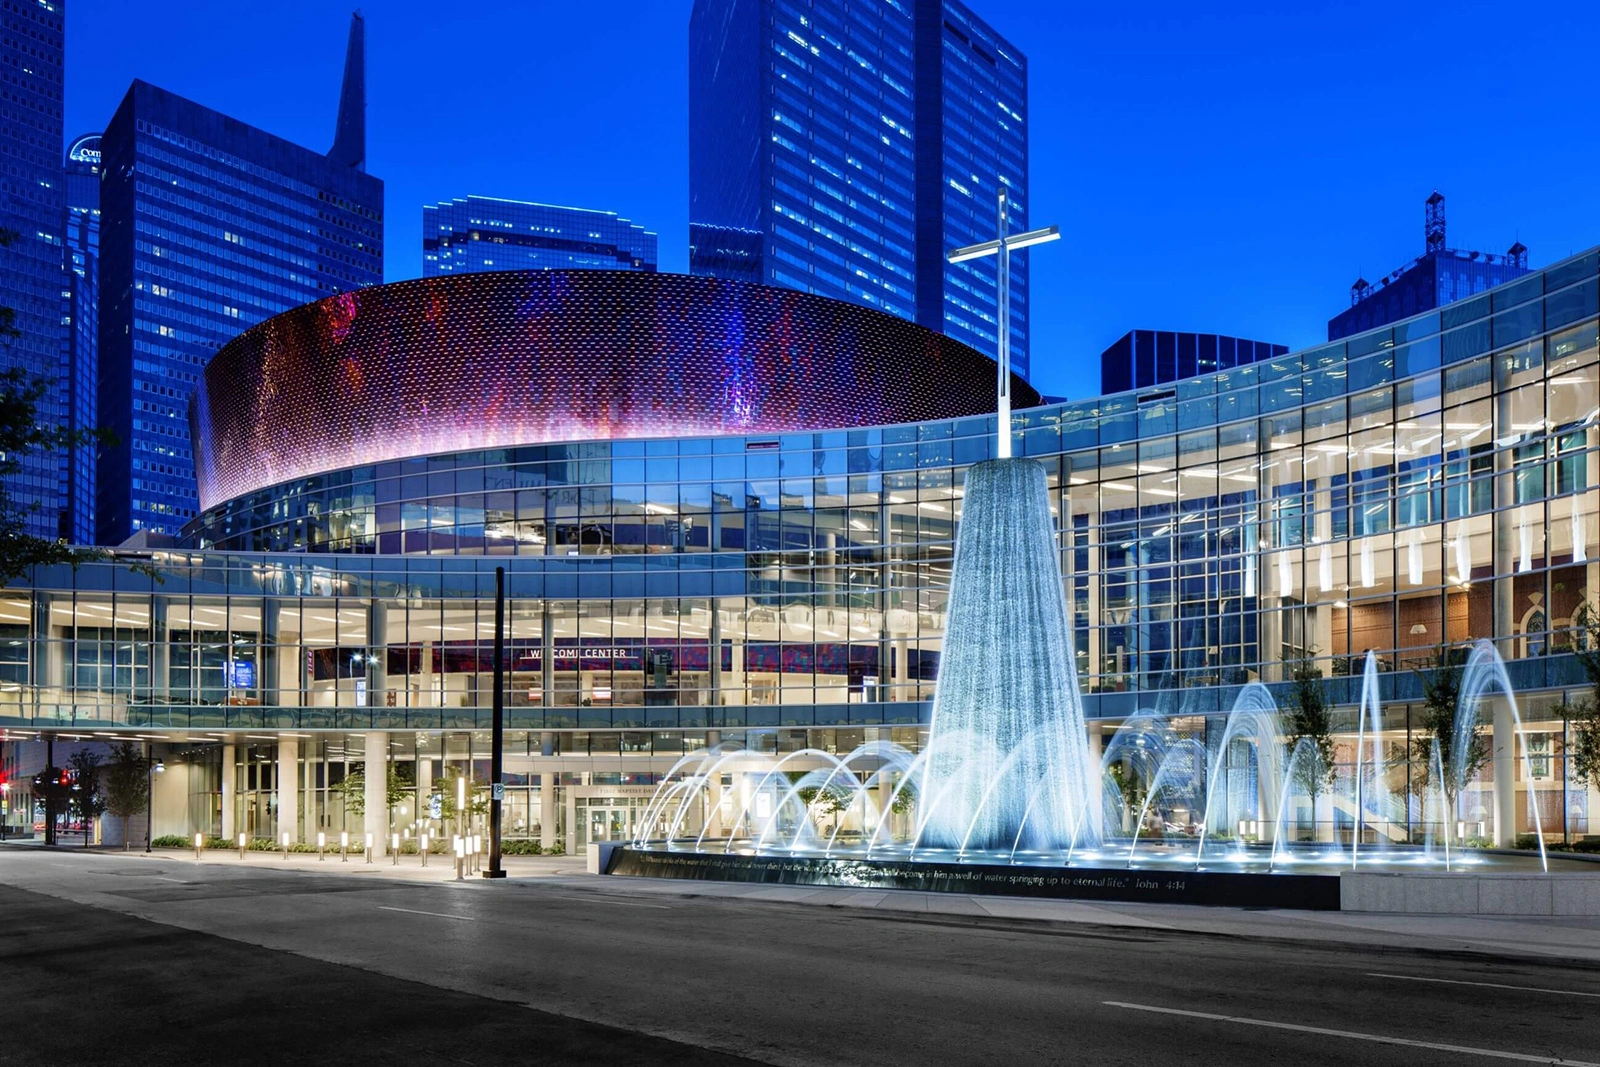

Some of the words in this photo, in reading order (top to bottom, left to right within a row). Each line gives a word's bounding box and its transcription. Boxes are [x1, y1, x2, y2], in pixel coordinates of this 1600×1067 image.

[530, 649, 580, 658] WCOM
[585, 649, 626, 658] CENTER
[926, 869, 933, 877] in
[933, 870, 948, 879] him
[955, 871, 972, 880] well
[973, 871, 983, 880] of
[984, 873, 1007, 882] water
[1009, 873, 1045, 887] springing
[1047, 878, 1058, 887] up
[1061, 877, 1071, 885] to
[1073, 877, 1105, 887] eternal
[1135, 878, 1159, 889] John
[1166, 880, 1186, 891] 4:14
